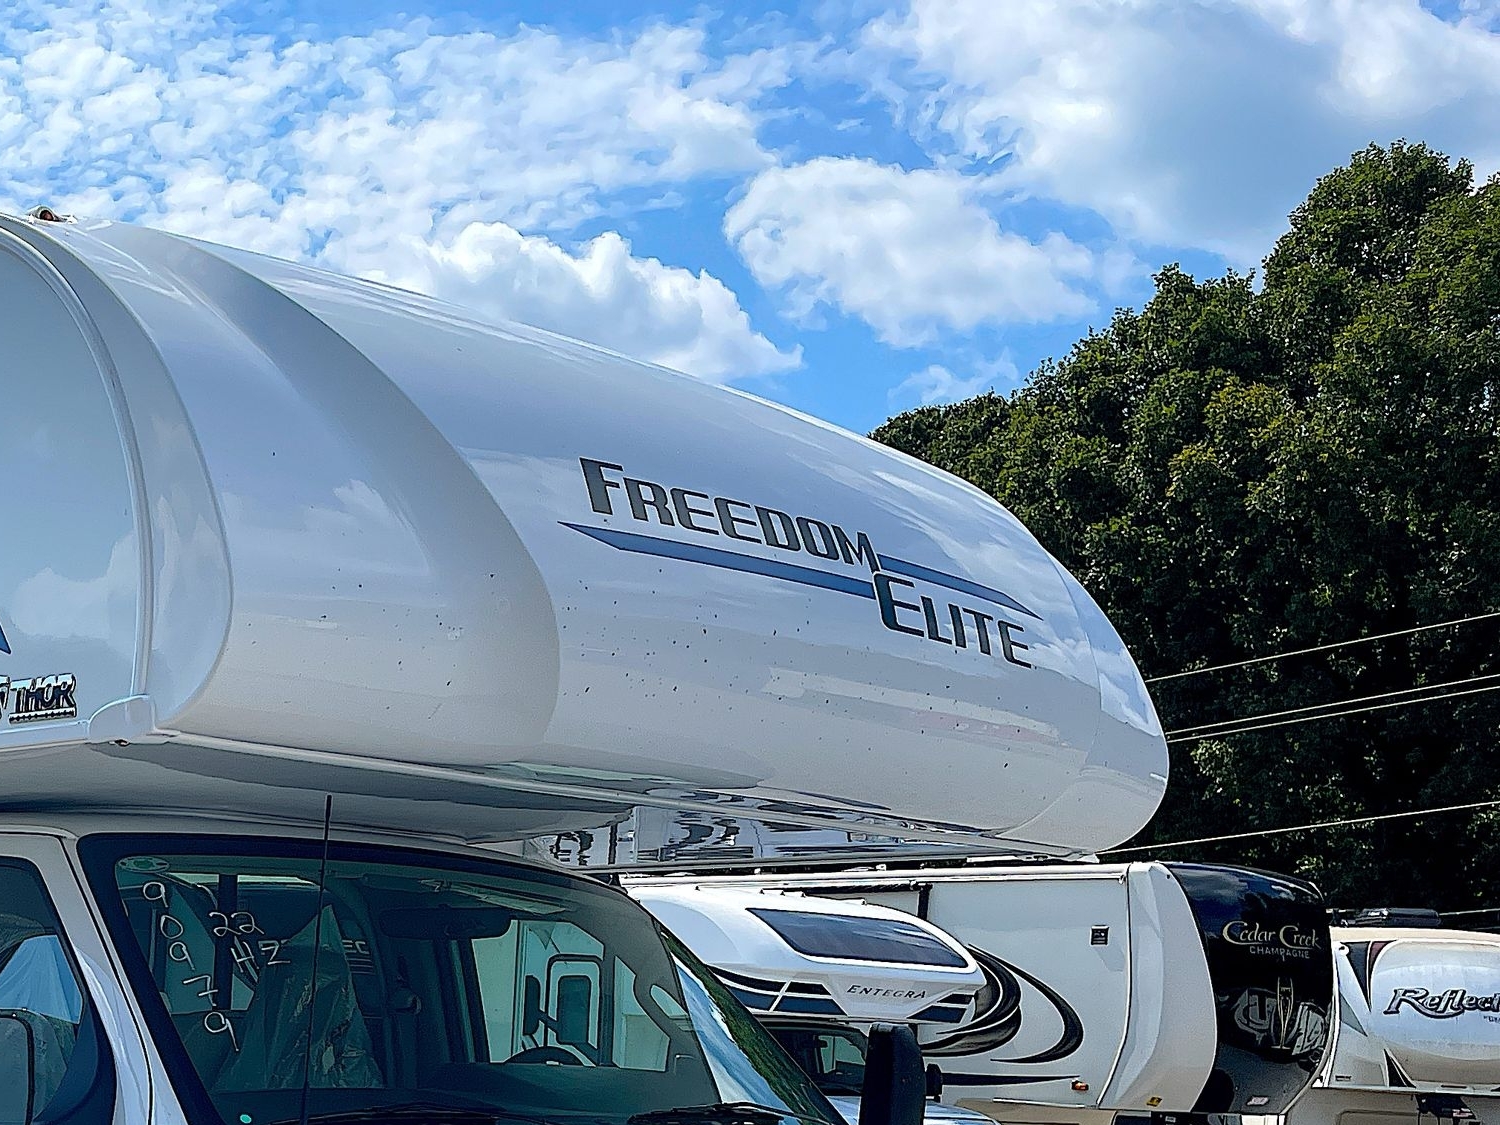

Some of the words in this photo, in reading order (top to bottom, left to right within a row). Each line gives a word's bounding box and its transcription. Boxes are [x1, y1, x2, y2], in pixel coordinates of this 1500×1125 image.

[579, 456, 880, 574] FREEDOM
[872, 571, 1033, 669] ELITE
[10, 673, 77, 713] THOR
[208, 911, 265, 937] 22
[1222, 920, 1277, 946] Cedar
[1279, 924, 1322, 949] Creek
[1249, 946, 1311, 960] CHAMPAGNE
[846, 984, 927, 999] ENTEGRA
